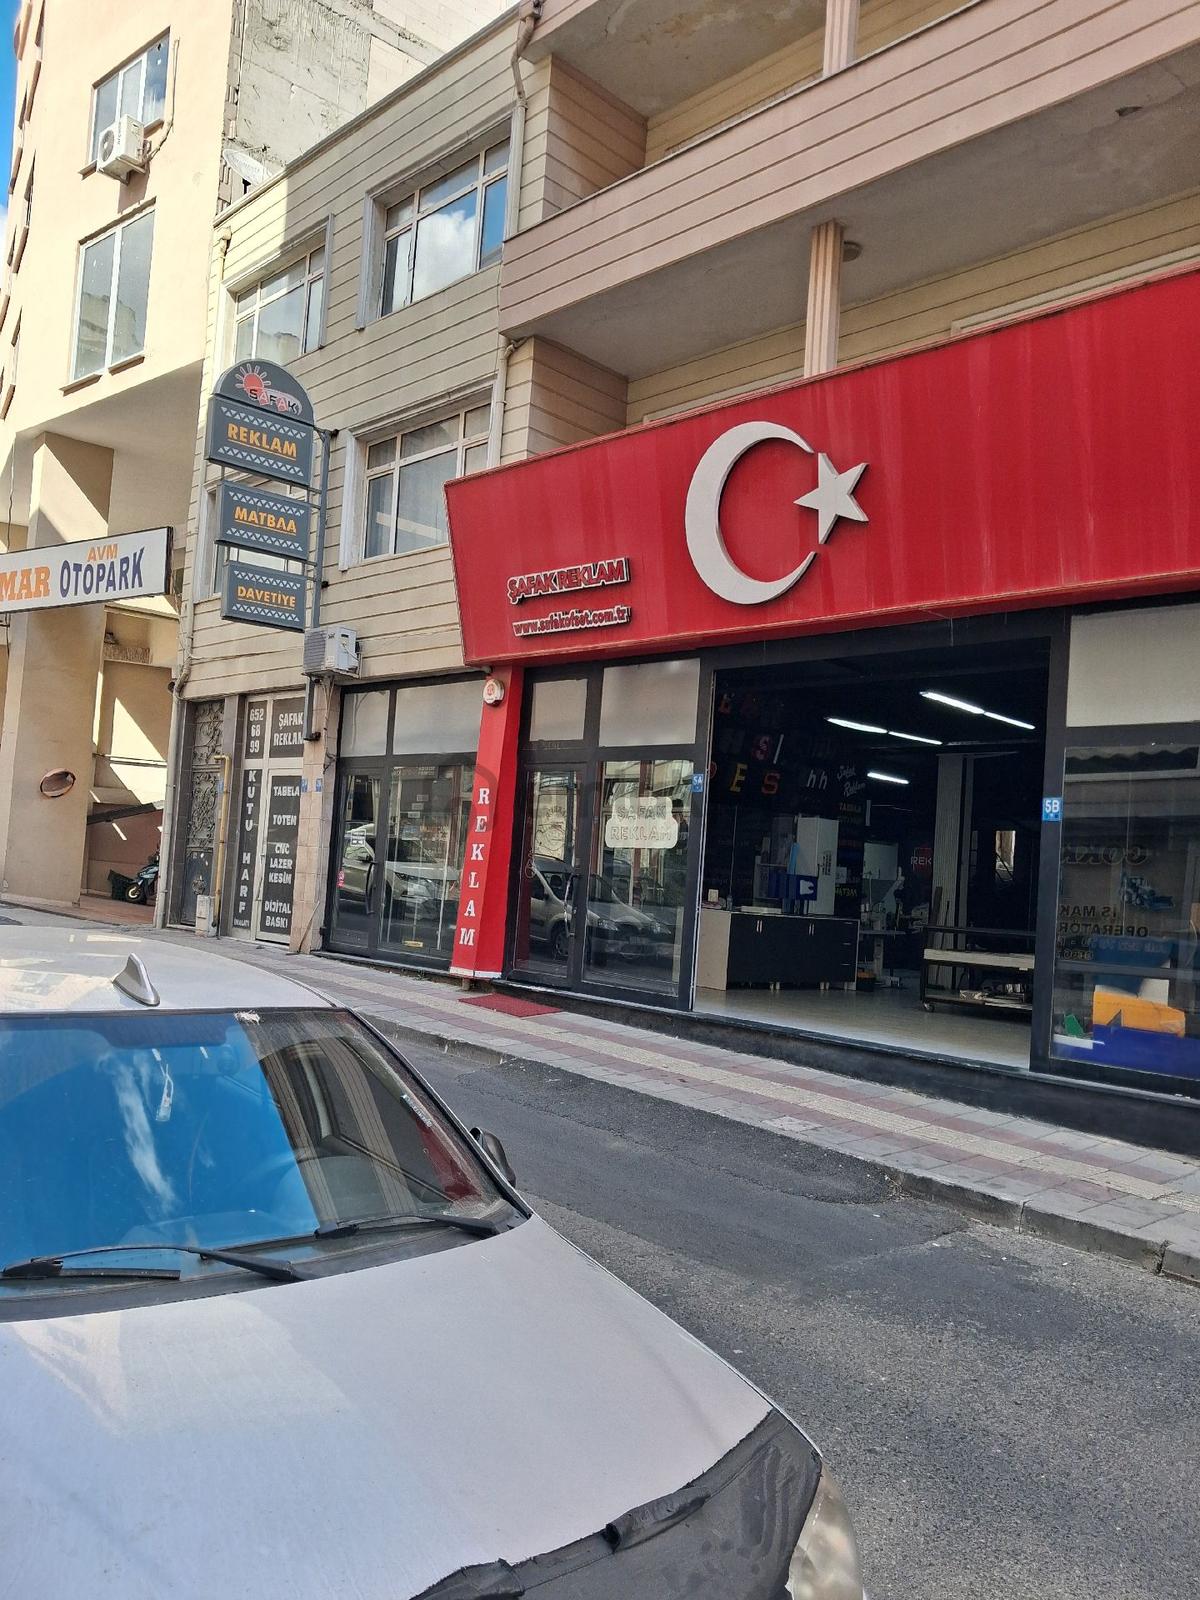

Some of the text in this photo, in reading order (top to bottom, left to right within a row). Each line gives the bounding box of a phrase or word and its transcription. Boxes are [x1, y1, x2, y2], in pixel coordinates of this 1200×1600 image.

[227, 423, 297, 459] REKLAM
[234, 506, 297, 533] MATBAA
[87, 544, 118, 562] AVM
[60, 547, 145, 598] OTOPARK
[507, 558, 627, 604] ŞAFAK REKLAM
[237, 586, 296, 607] DAVETİYE
[250, 708, 264, 721] 652
[279, 712, 304, 730] ŞAFAK
[251, 724, 261, 737] 68
[250, 740, 260, 753] 99
[273, 786, 300, 797] TABELA
[245, 770, 257, 832] KUTU
[1045, 799, 1060, 814] 5B
[273, 815, 297, 826] TOTEM
[610, 826, 672, 841] REKLAM
[275, 843, 290, 855] CNC
[270, 858, 293, 870] LAZER
[459, 787, 490, 946] REKLAM
[239, 852, 251, 914] HARF
[269, 872, 292, 885] KESİM
[265, 916, 288, 928] BASKI
